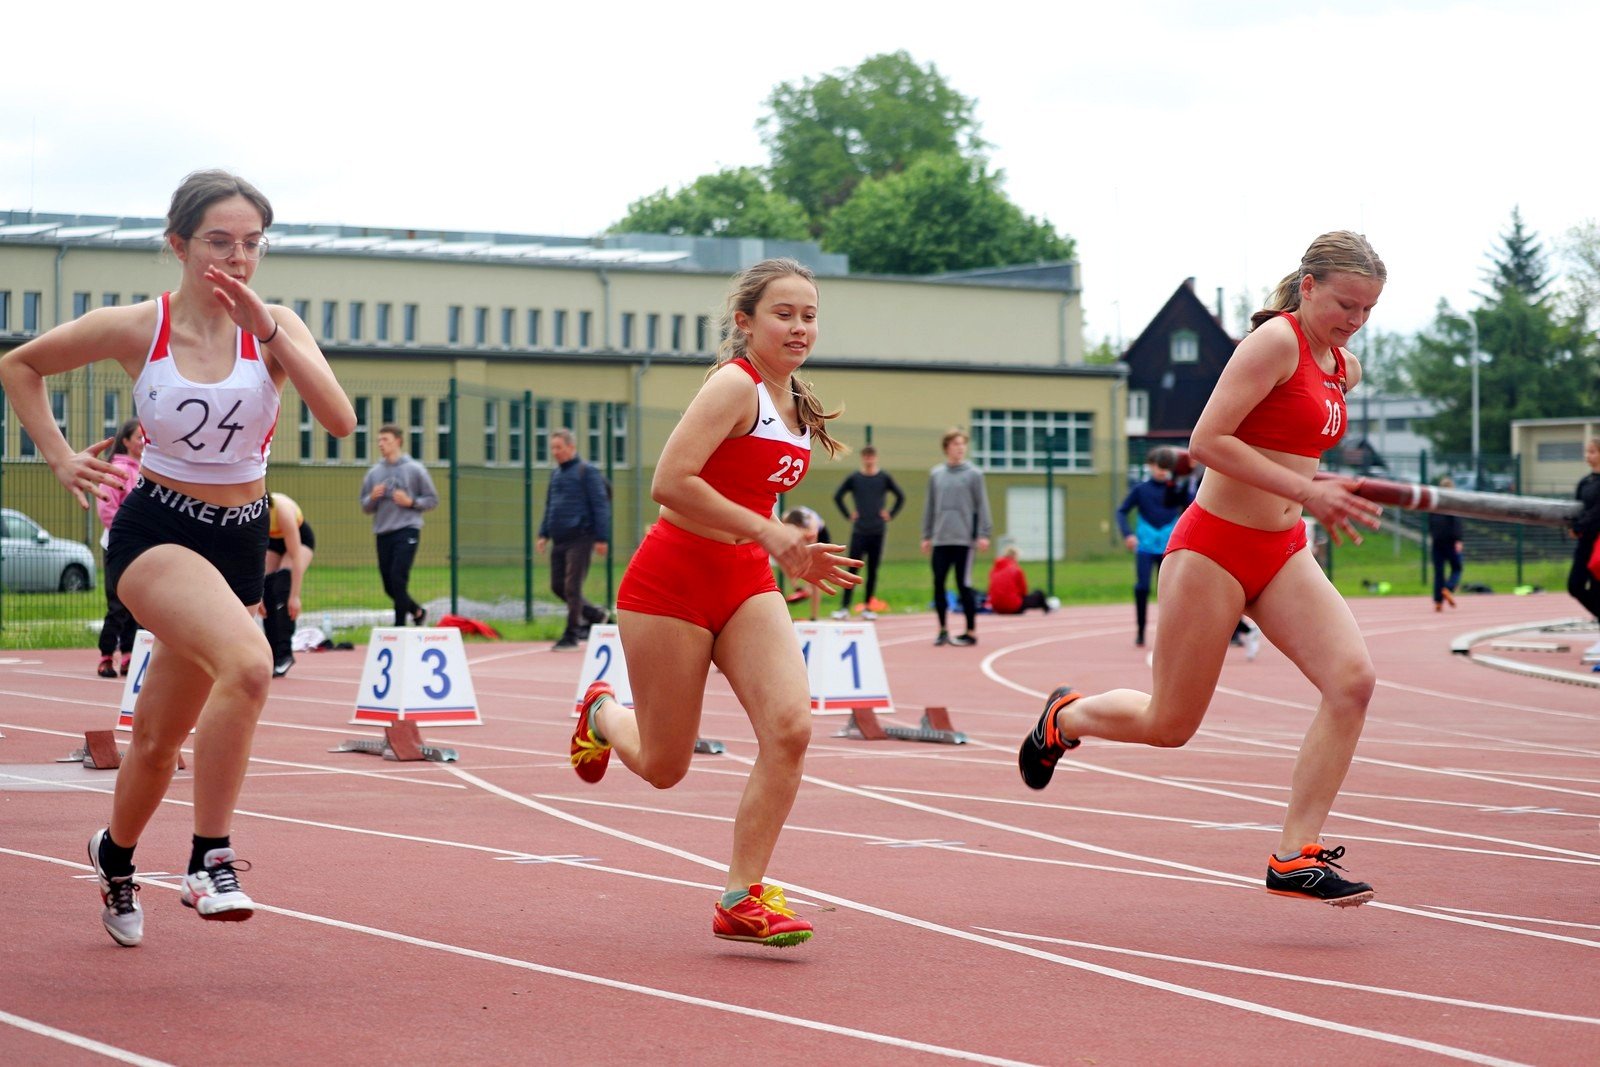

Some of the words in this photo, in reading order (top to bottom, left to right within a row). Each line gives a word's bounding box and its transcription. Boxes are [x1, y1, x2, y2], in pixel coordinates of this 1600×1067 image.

[172, 398, 245, 454] 24
[1321, 399, 1342, 437] 20
[767, 455, 804, 487] 23
[149, 484, 220, 525] NIKE
[220, 499, 263, 527] PRO
[373, 648, 393, 700] 3
[421, 648, 452, 700] 3
[595, 644, 611, 681] 2
[841, 641, 861, 689] 1
